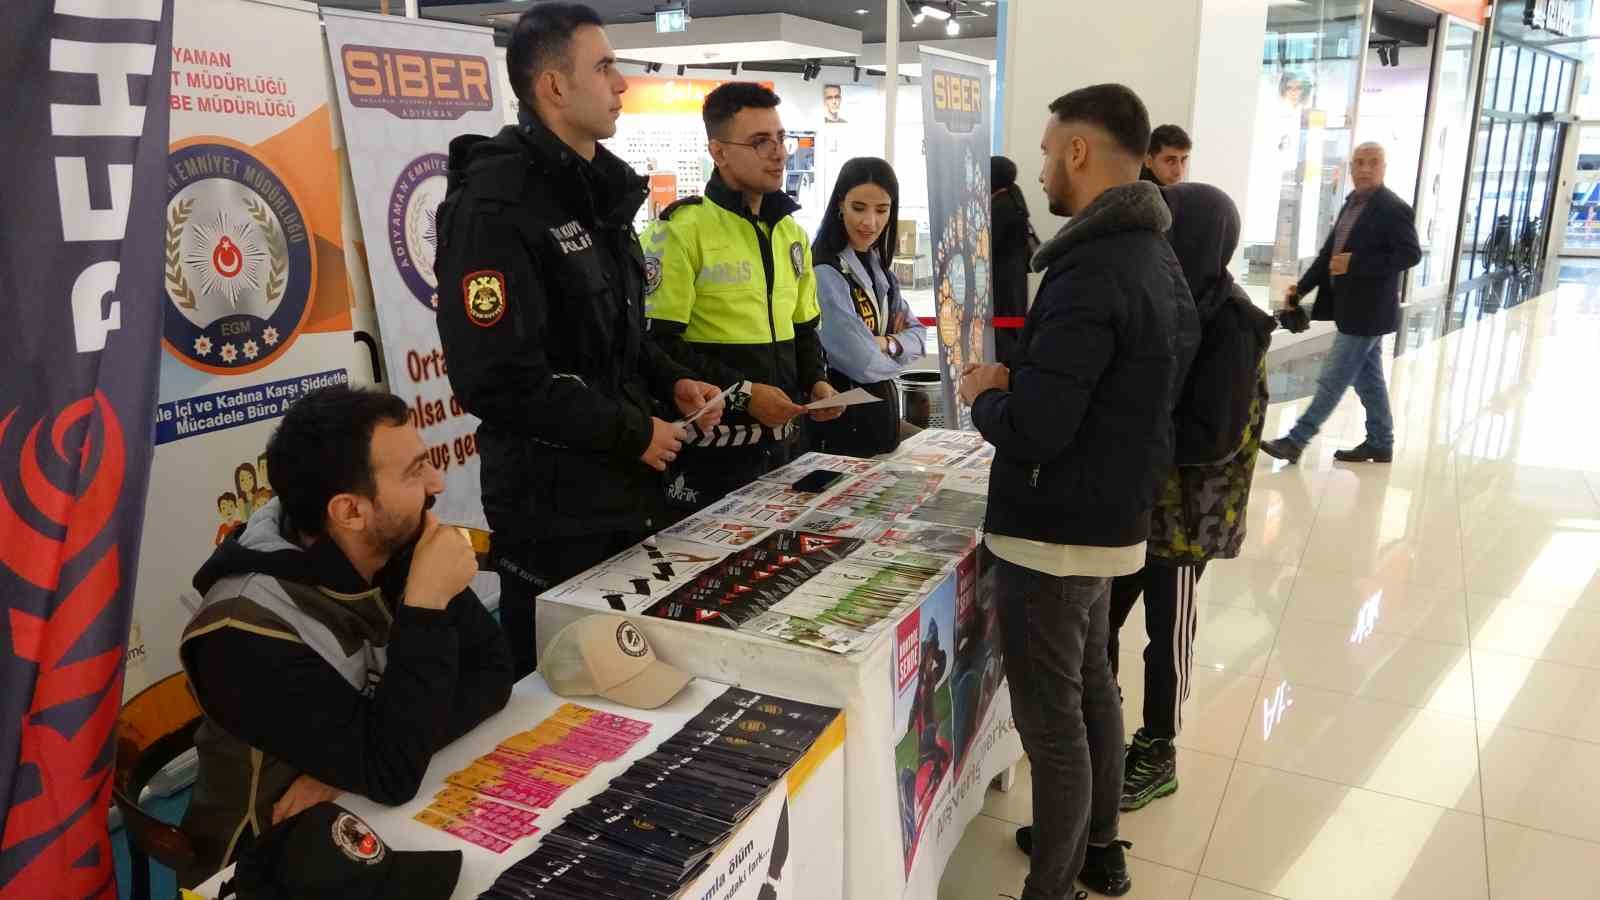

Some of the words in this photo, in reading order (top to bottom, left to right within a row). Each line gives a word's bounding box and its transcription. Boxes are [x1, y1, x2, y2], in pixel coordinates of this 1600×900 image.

[186, 69, 287, 96] MÜDÜRLÜĞÜ
[196, 93, 296, 118] MÜDÜRLÜĞÜ
[176, 153, 240, 180] EMNİYET
[393, 180, 410, 268] ADIYAMAN
[220, 321, 251, 337] EGM
[194, 401, 213, 414] ve
[217, 391, 264, 410] Kadına
[266, 383, 299, 398] Karşı
[176, 411, 246, 436] Mücadele
[248, 401, 279, 420] Büro
[728, 839, 755, 875] ölüm
